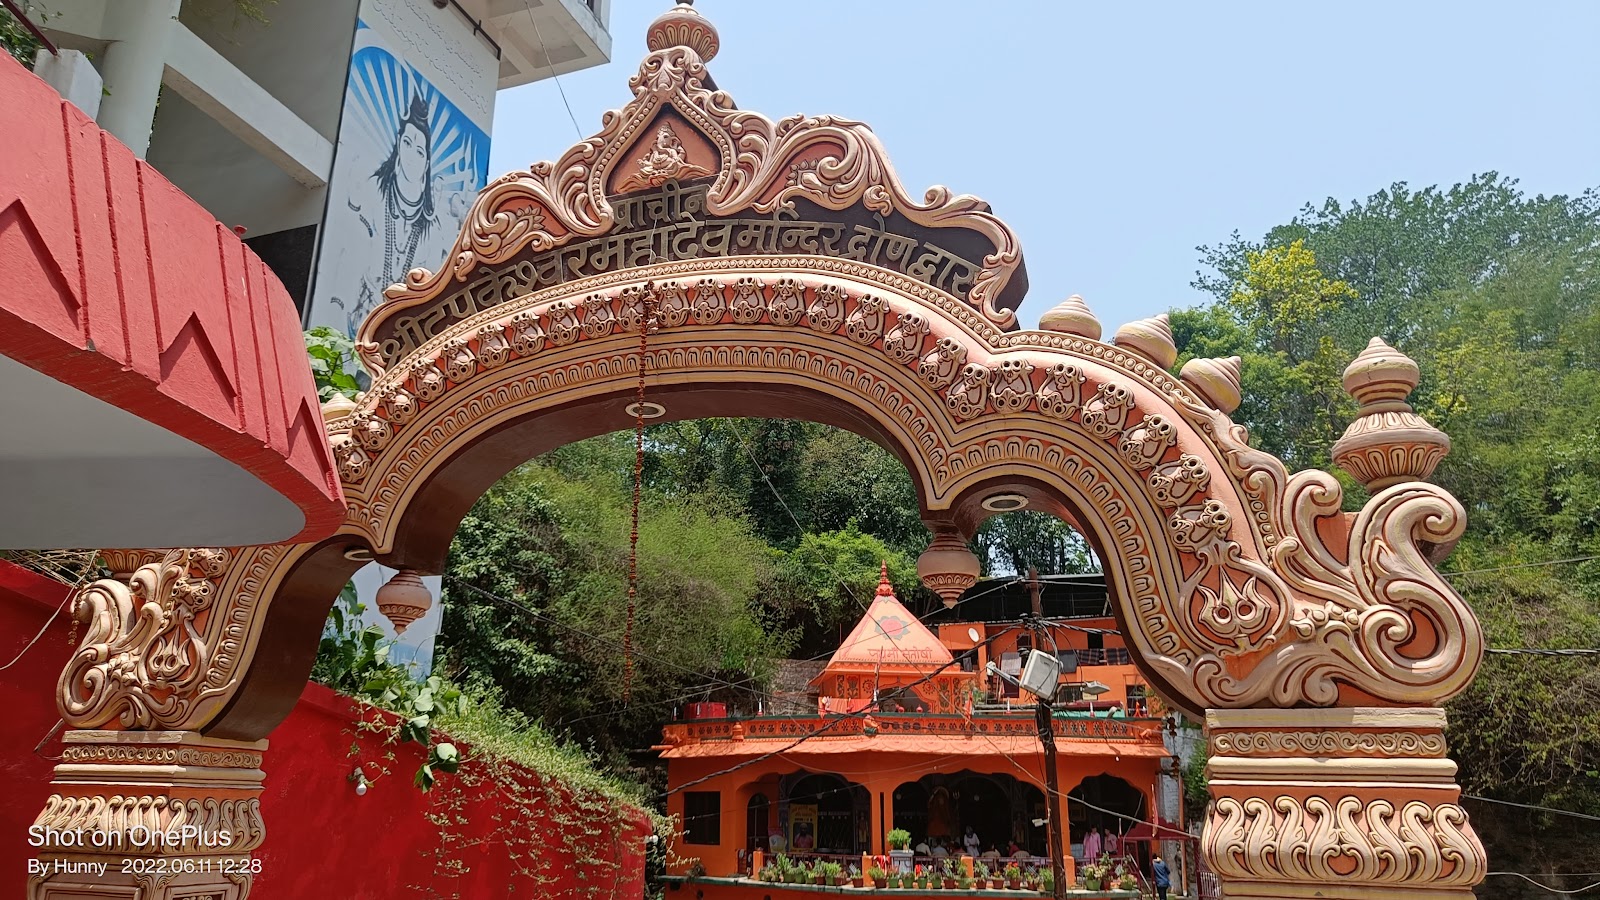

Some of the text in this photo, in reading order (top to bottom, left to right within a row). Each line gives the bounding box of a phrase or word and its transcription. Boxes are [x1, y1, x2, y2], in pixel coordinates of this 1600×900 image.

[611, 178, 712, 235] प्राचीन
[379, 316, 426, 372] श्री
[589, 211, 740, 271] महादेव
[838, 212, 919, 274] द्रोण
[905, 241, 983, 301] द्वार
